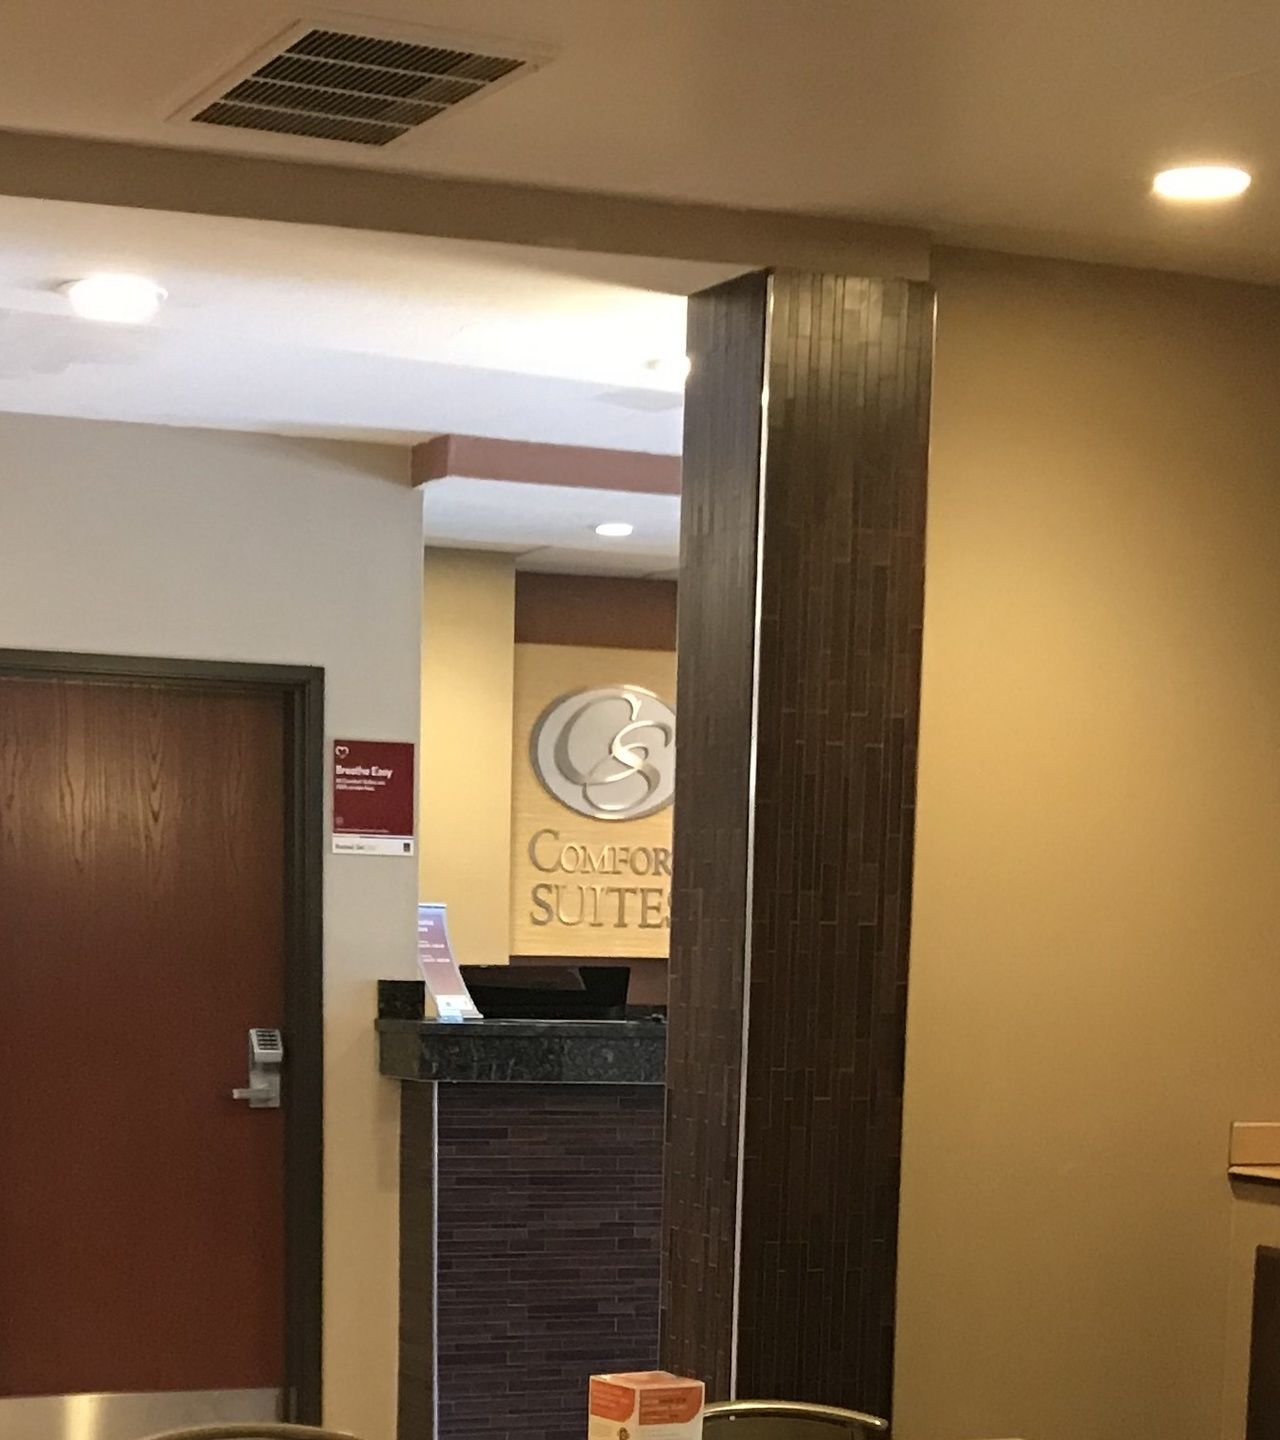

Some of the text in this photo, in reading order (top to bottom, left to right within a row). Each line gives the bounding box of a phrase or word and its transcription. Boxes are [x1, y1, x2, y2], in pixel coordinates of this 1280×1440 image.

[371, 766, 393, 779] Easy
[527, 828, 673, 877] COMFOR
[530, 882, 672, 929] SUITE
